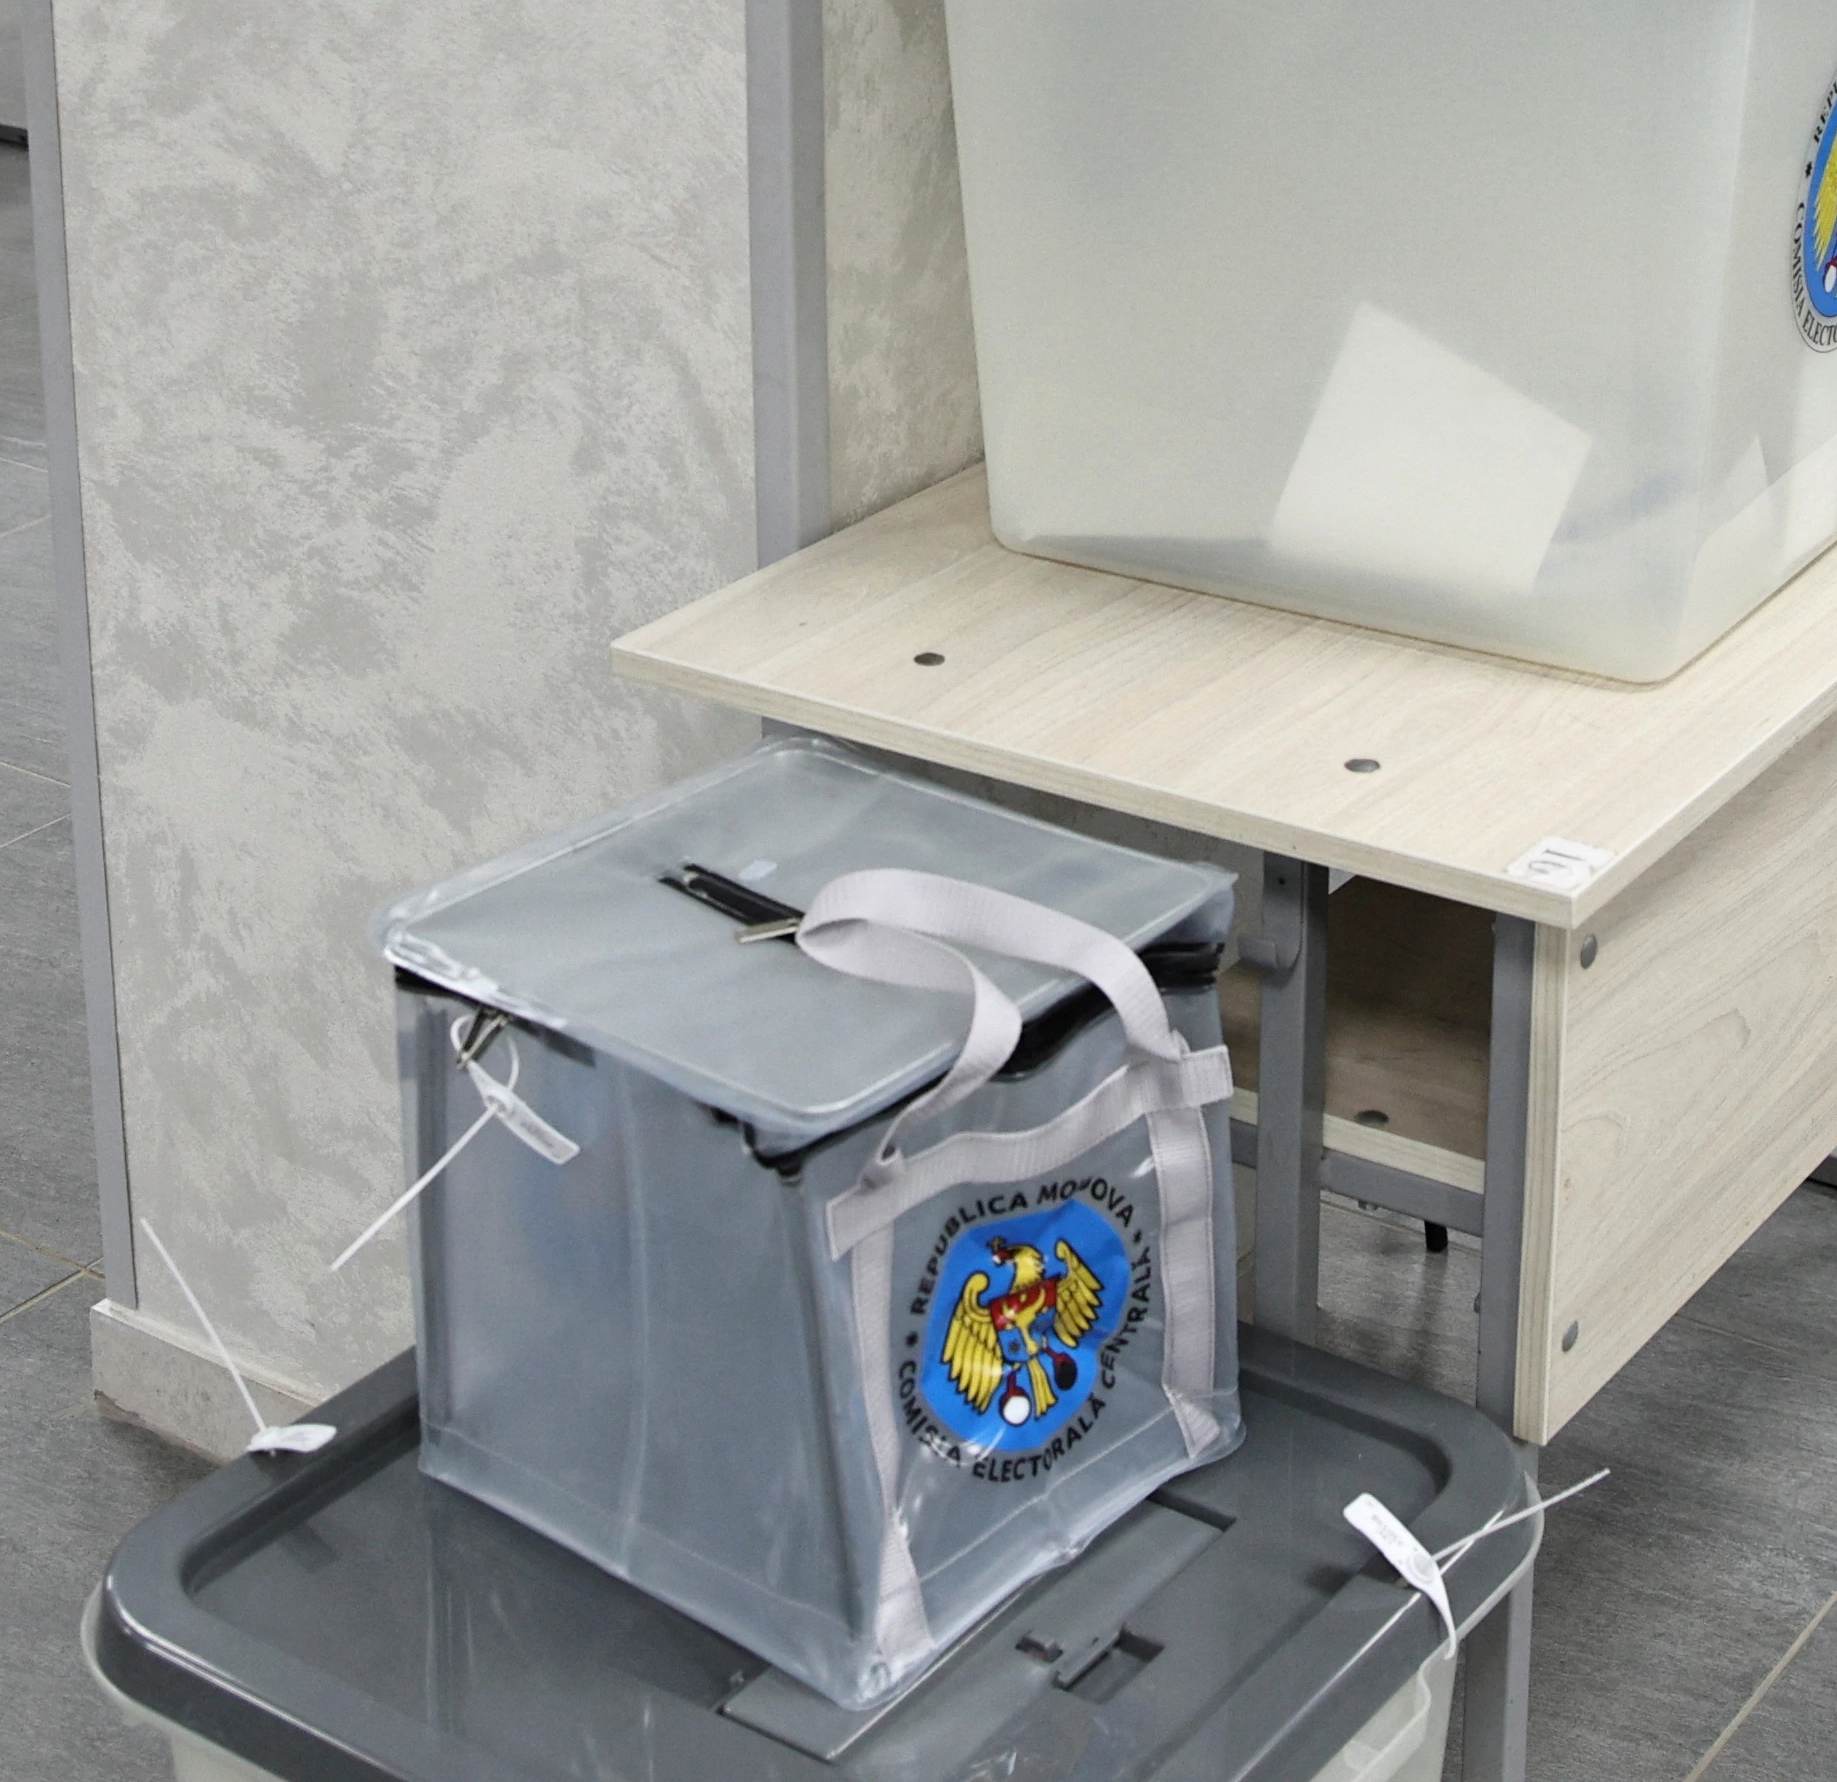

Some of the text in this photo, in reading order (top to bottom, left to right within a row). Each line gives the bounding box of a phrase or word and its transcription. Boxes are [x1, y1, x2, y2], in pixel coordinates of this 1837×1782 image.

[910, 1176, 1134, 1316] REPUBLICA MOOVA
[898, 1361, 962, 1467] COMISA
